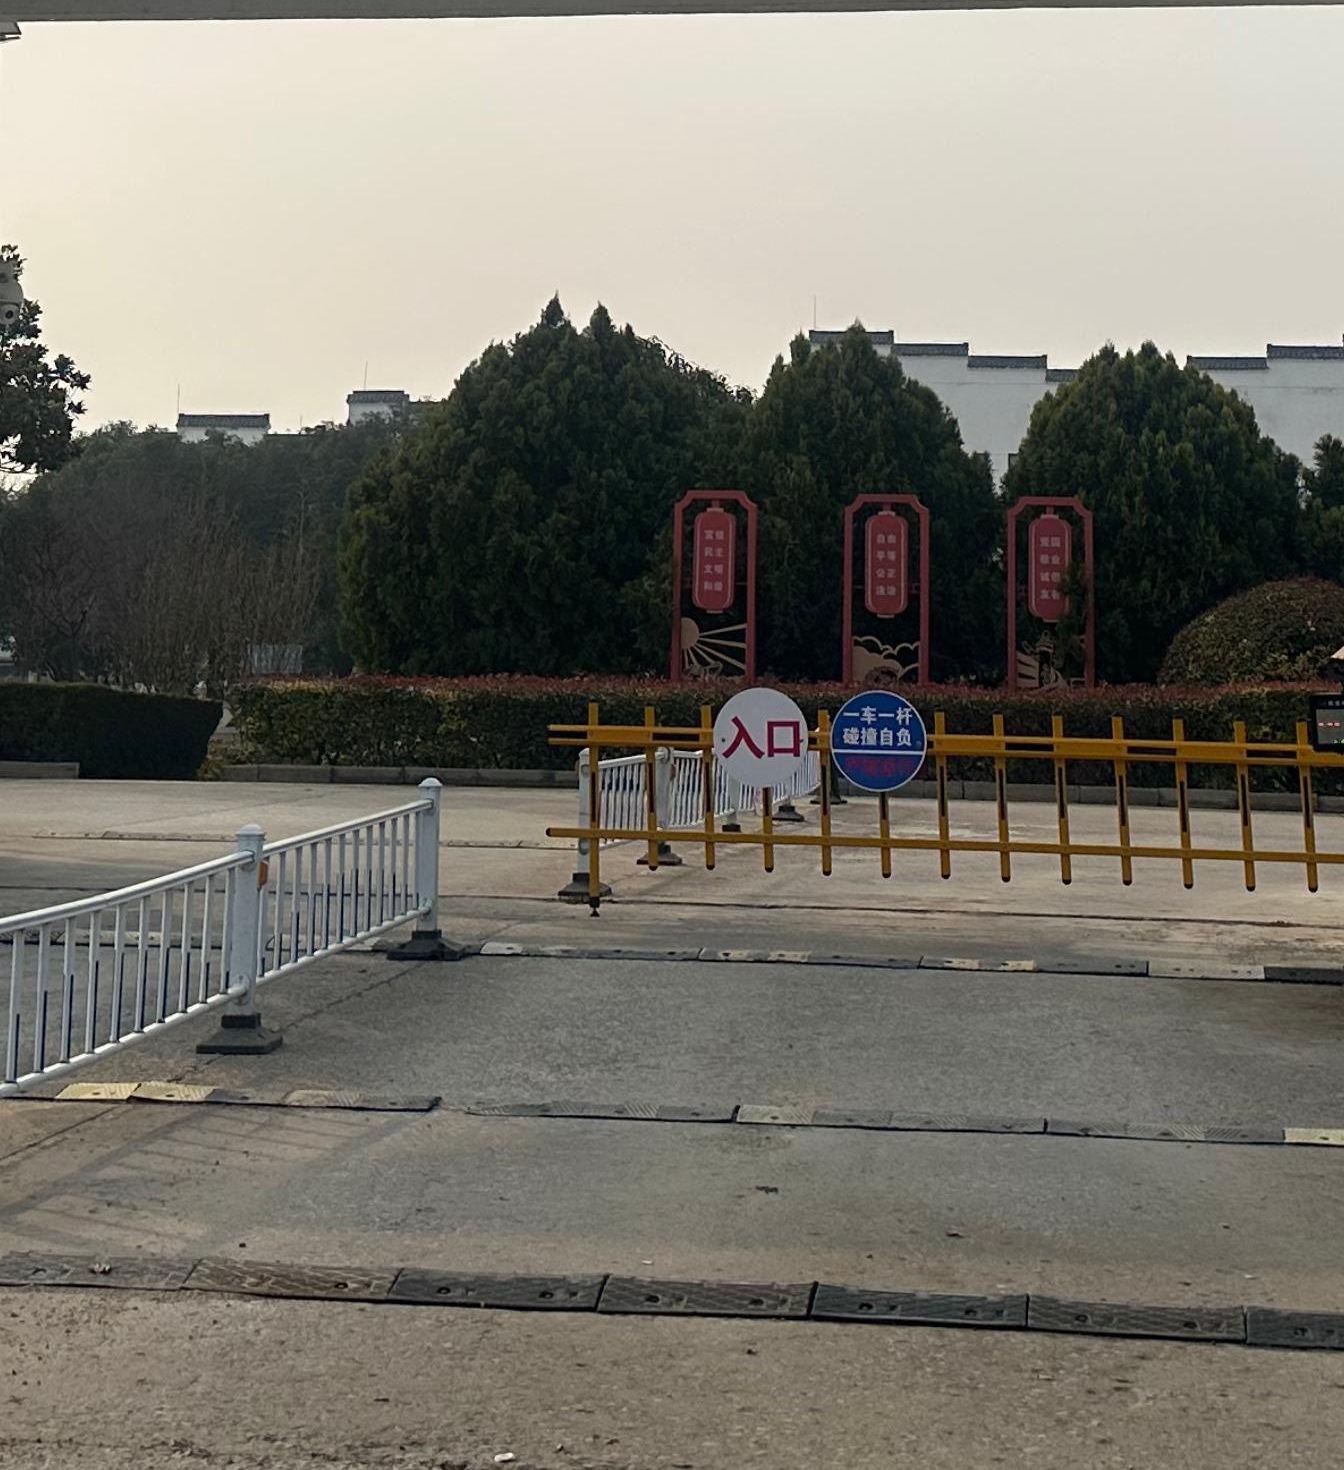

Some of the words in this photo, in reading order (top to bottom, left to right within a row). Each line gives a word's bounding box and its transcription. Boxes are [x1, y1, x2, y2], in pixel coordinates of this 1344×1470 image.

[842, 705, 913, 726] 一车一杆
[722, 716, 801, 760] 入口
[842, 726, 913, 747] 碰撞自负
